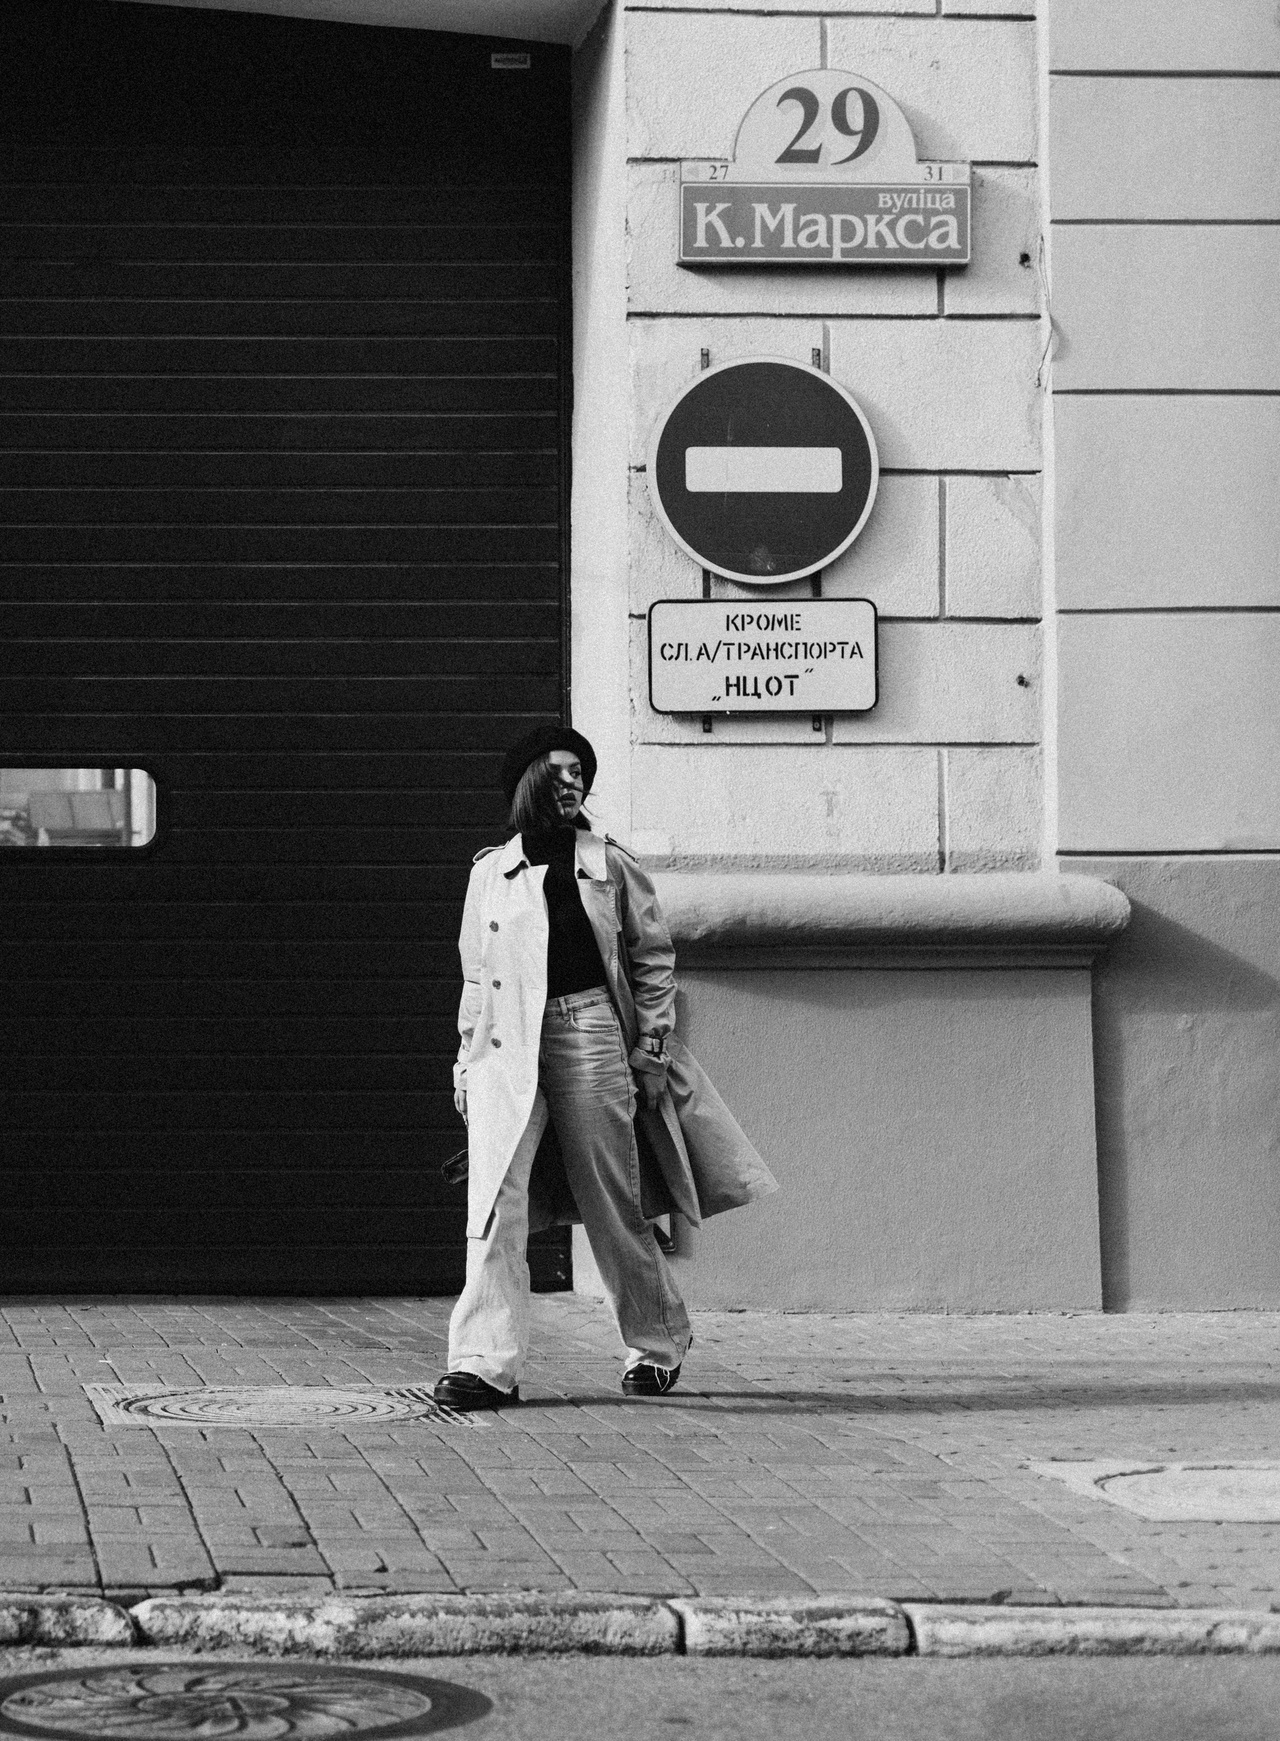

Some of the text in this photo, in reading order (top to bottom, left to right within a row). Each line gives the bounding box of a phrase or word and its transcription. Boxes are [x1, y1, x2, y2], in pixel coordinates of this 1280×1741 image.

[774, 86, 879, 165] 29
[709, 166, 729, 181] 27
[923, 166, 944, 182] 31
[878, 189, 956, 212] вуліца
[726, 614, 802, 631] КРОМЕ
